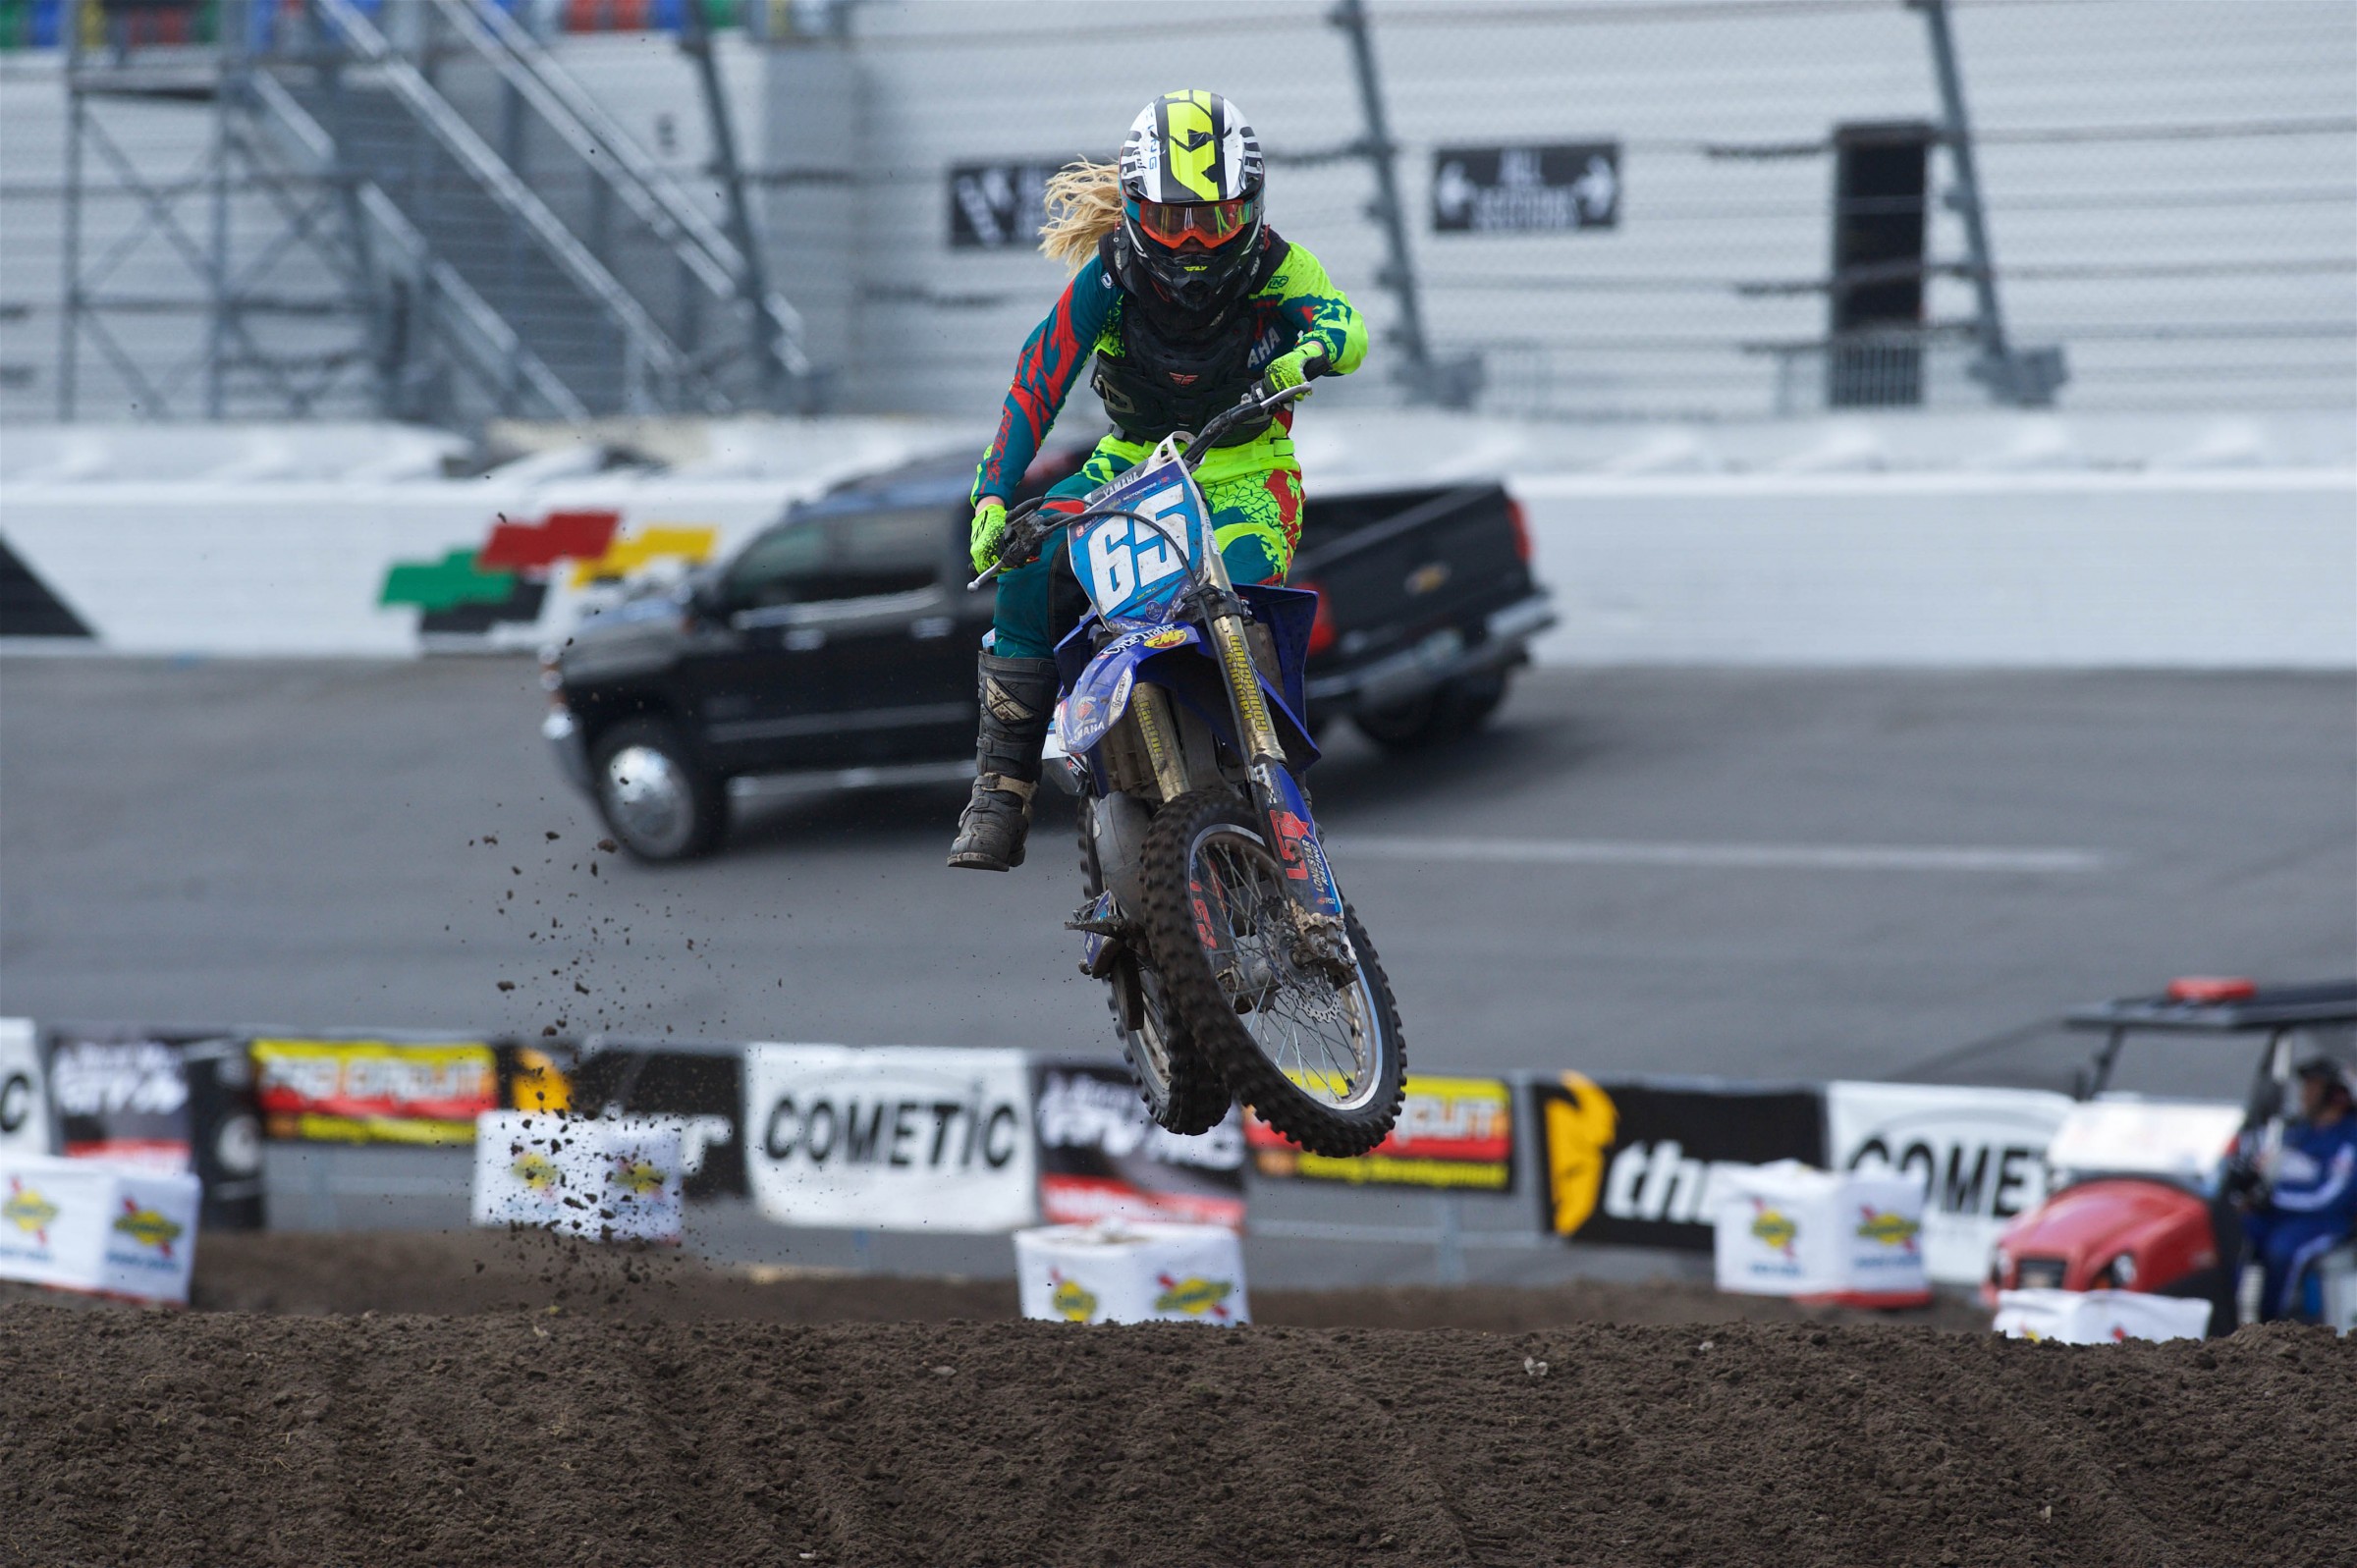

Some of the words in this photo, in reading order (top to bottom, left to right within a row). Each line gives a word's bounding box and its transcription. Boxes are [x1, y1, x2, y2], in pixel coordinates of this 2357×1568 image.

[1247, 327, 1281, 369] AHA
[1102, 471, 1140, 497] YAMAHA
[1087, 481, 1190, 616] 65
[1138, 622, 1177, 641] Trader
[1143, 629, 1185, 648] FMF
[1225, 652, 1253, 720] Factory
[1229, 635, 1270, 731] Connection
[1301, 839, 1325, 893] LONESTAR
[1311, 844, 1329, 887] RACING
[765, 1090, 1017, 1168] COMETIC
[1604, 1139, 1719, 1225] th
[1846, 1137, 2051, 1218] COME
